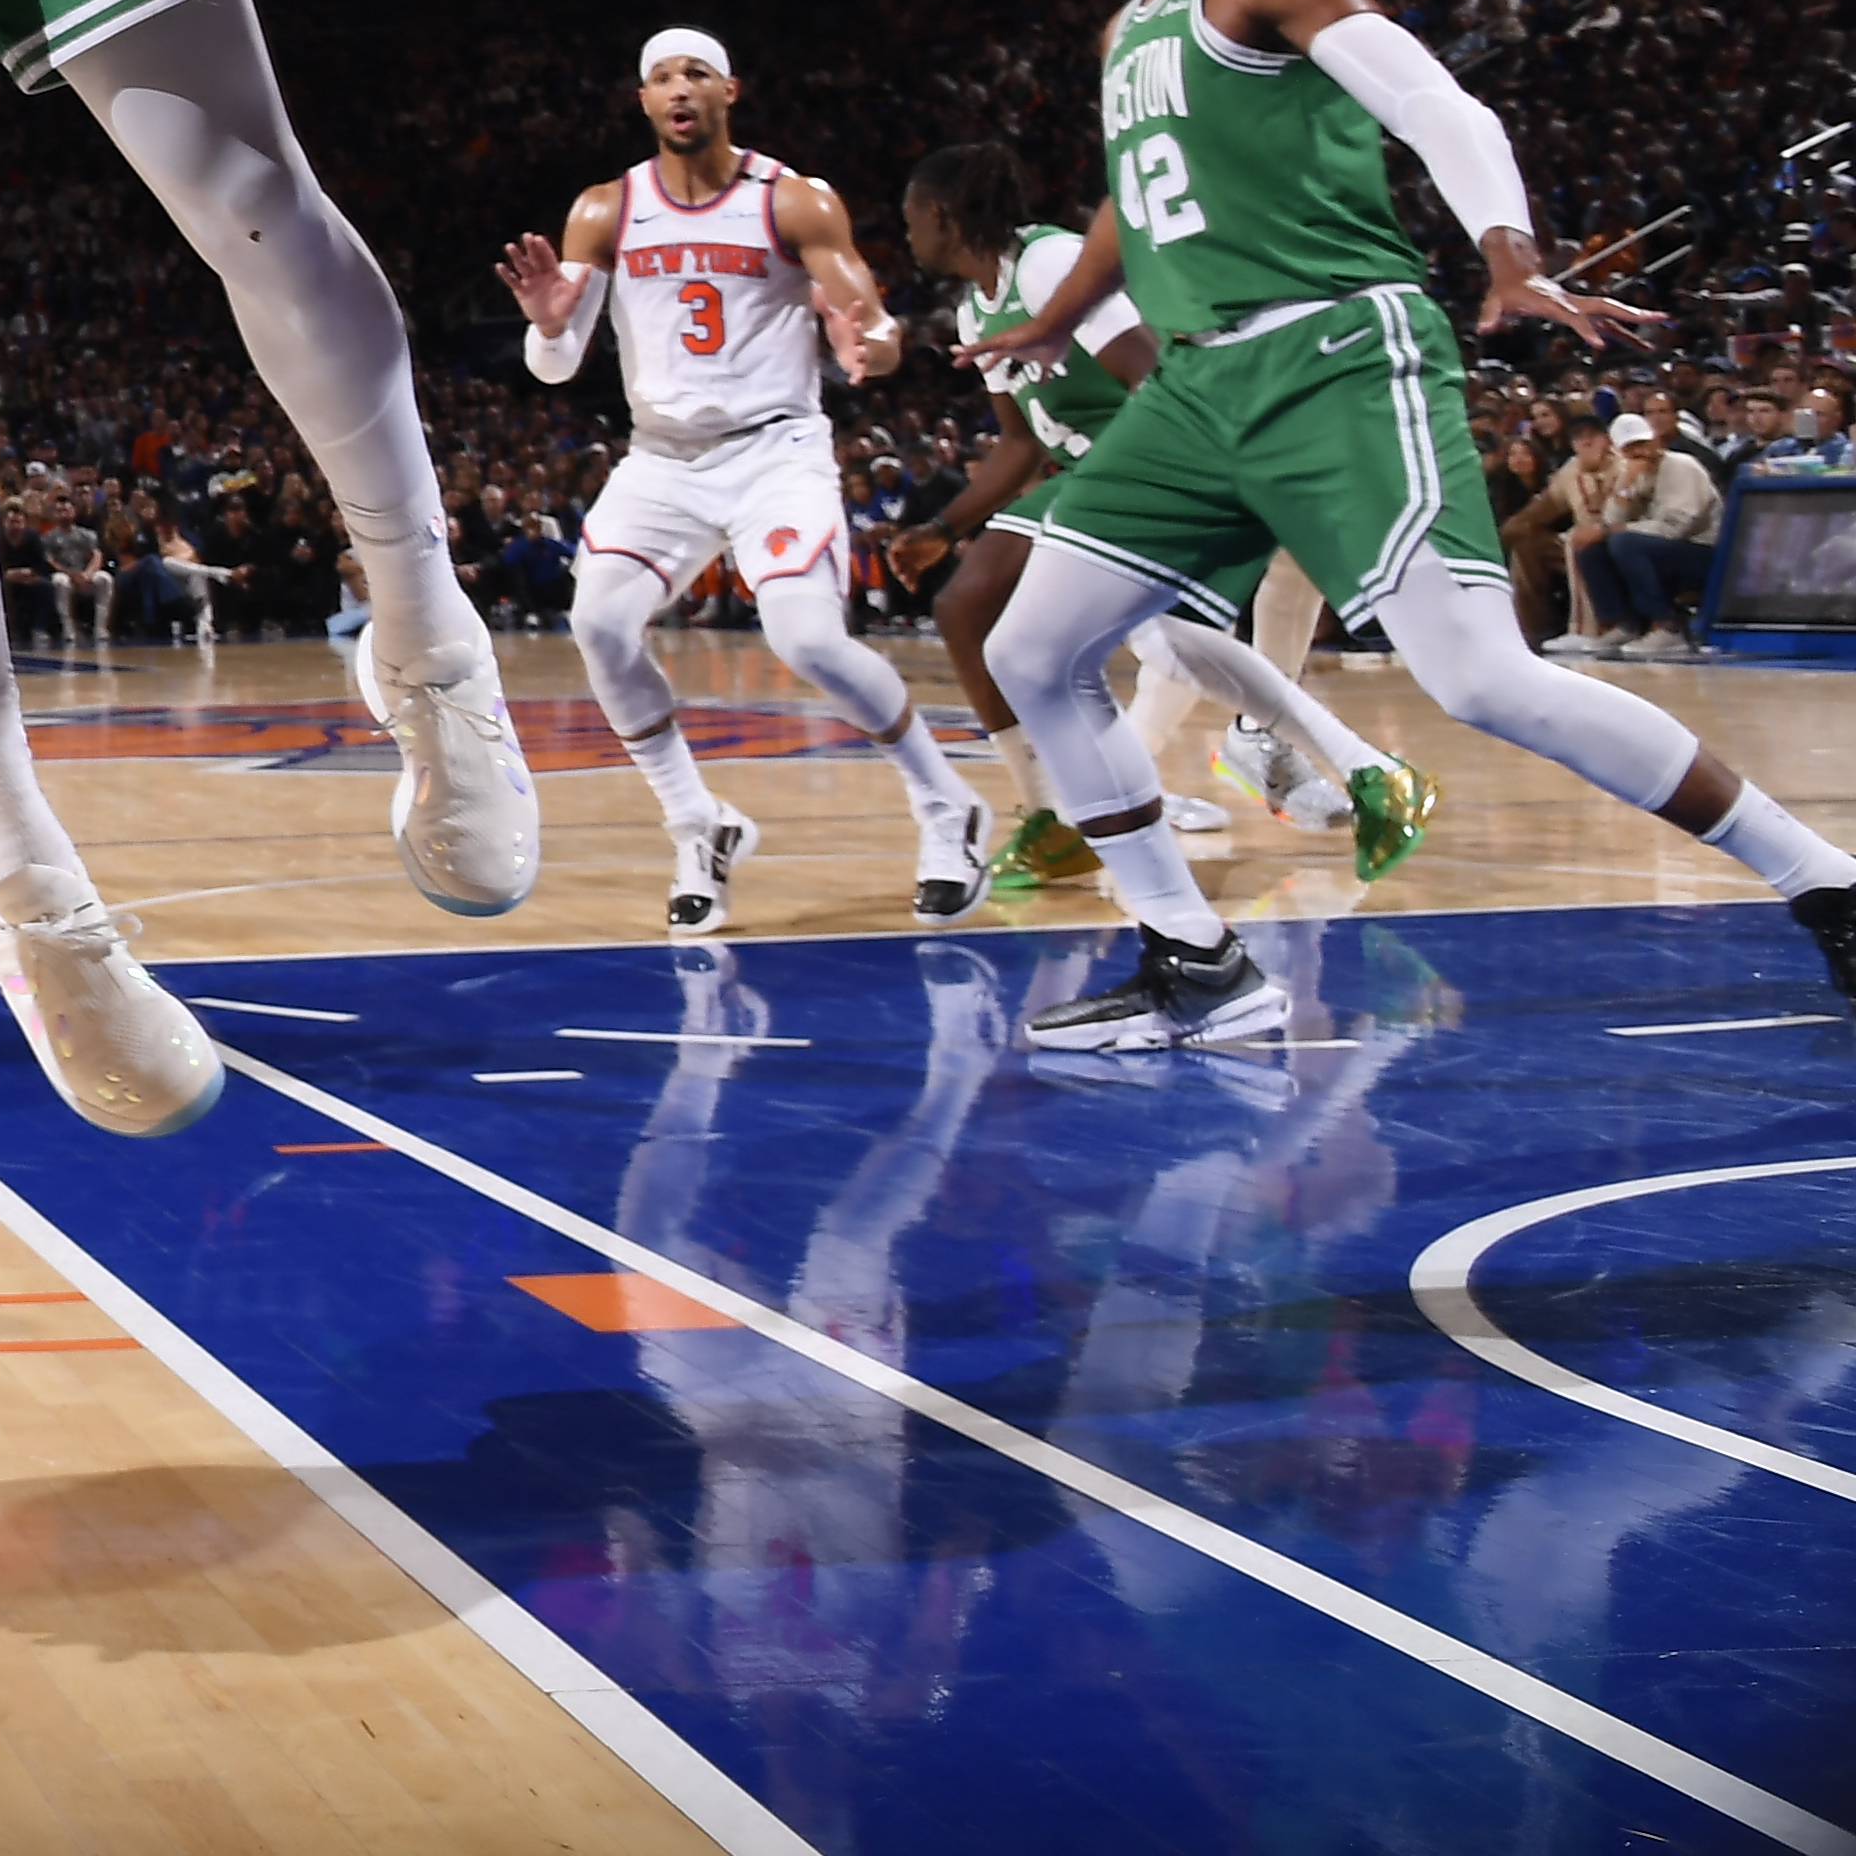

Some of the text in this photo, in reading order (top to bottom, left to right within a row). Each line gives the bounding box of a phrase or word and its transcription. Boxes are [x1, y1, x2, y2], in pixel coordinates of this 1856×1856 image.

[1119, 132, 1207, 248] 42
[622, 242, 769, 280] NEW YORK
[677, 280, 726, 356] 3
